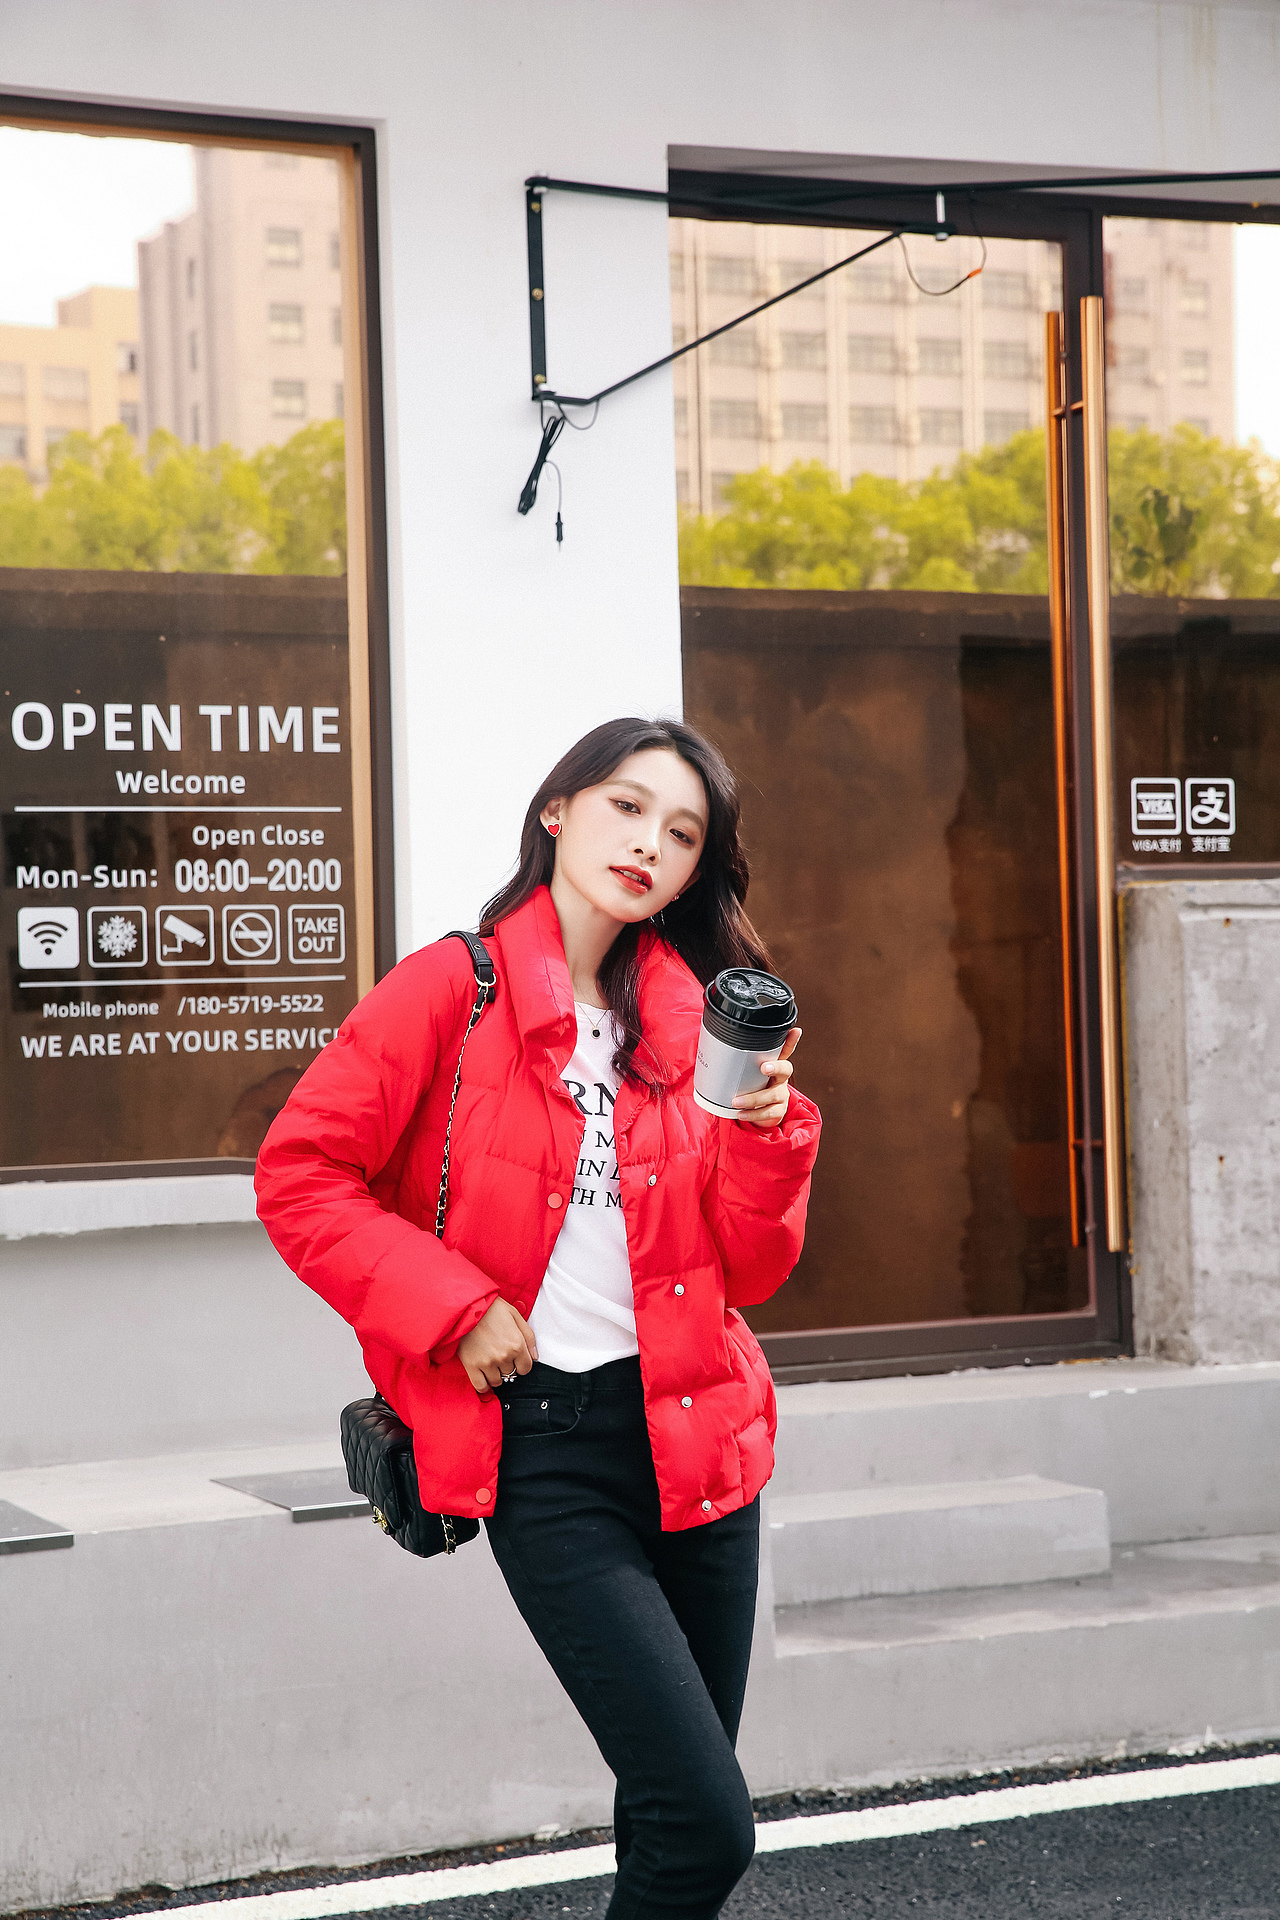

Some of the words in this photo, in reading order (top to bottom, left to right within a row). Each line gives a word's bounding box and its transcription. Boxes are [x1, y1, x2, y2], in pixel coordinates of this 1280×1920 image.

[12, 702, 181, 751] OPEN
[199, 705, 340, 752] TIME
[116, 769, 245, 794] Welcome
[193, 826, 255, 850] Open
[262, 824, 324, 845] Close
[1192, 836, 1231, 853] 支付宝
[17, 865, 157, 888] Mon-Sun:
[295, 917, 338, 933] TAKE
[298, 936, 335, 952] OUT
[44, 1002, 101, 1018] Mobile
[105, 1001, 159, 1019] phone
[21, 1035, 62, 1058] WE
[69, 1034, 121, 1056] ARE
[128, 1032, 160, 1054] AT
[165, 1030, 239, 1052] YOUR
[245, 1028, 339, 1051] SERVIC
